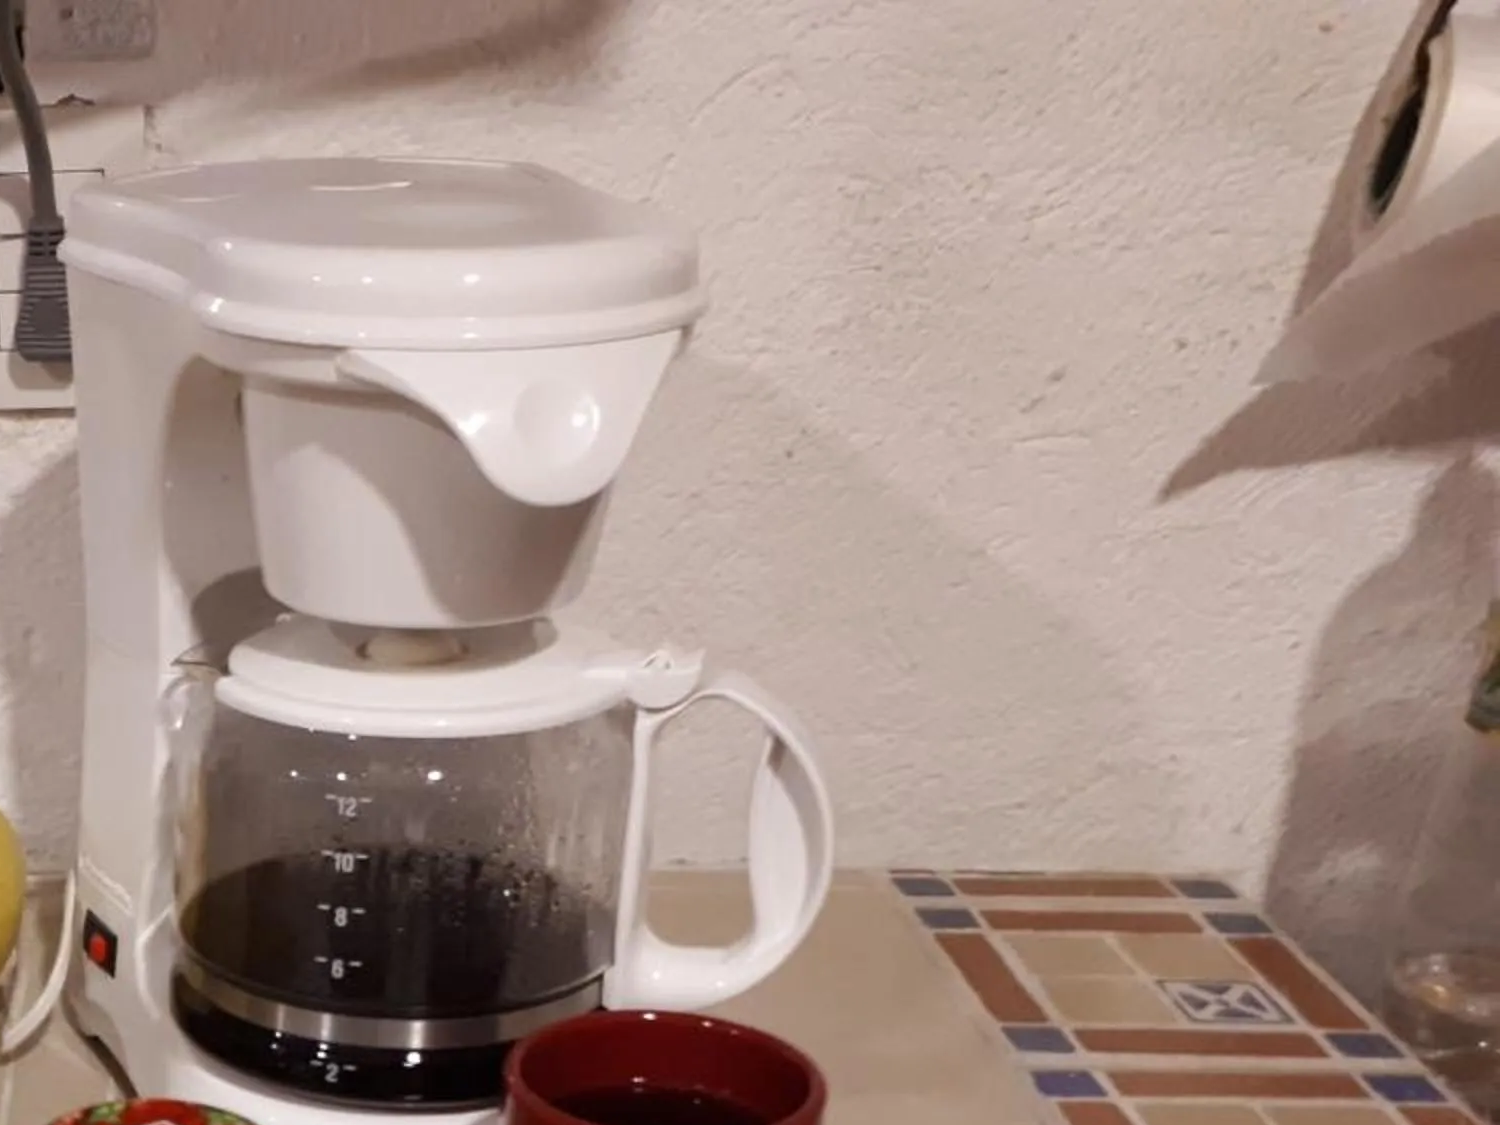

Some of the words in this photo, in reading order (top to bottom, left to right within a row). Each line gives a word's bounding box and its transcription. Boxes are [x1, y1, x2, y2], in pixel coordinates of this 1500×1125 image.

[336, 797, 357, 817] 12
[334, 857, 355, 873] 10
[334, 906, 348, 927] 8
[331, 959, 344, 979] 6
[325, 1063, 340, 1083] 2
